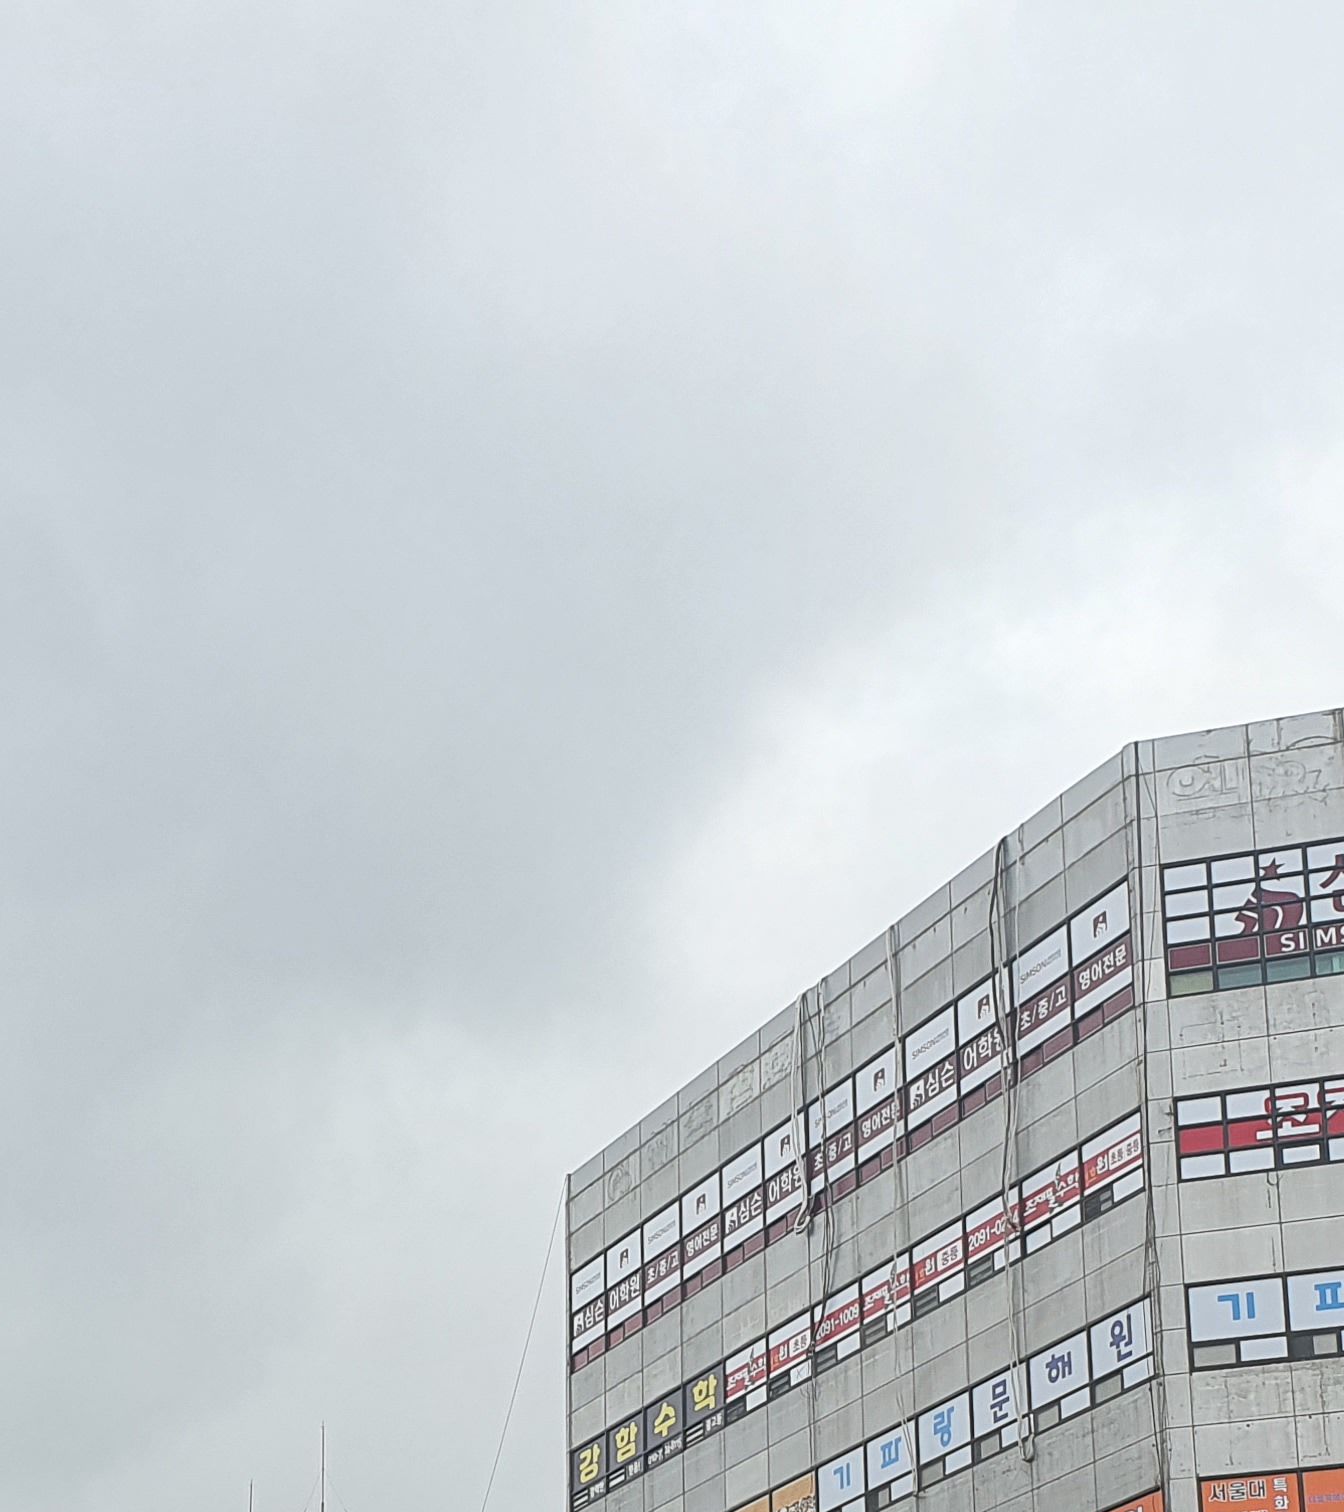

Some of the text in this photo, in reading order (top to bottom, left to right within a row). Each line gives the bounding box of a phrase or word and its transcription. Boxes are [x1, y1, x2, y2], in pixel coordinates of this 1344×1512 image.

[925, 1060, 956, 1099] 심슨
[1019, 984, 1068, 1031] 초/중/고
[1077, 943, 1129, 991] 영어전문
[737, 1191, 763, 1226] 심슨
[583, 1297, 606, 1329] 심슨
[608, 1272, 642, 1312] 어학원
[685, 1221, 720, 1258] 영어전문
[1209, 1477, 1267, 1502] 서울대
